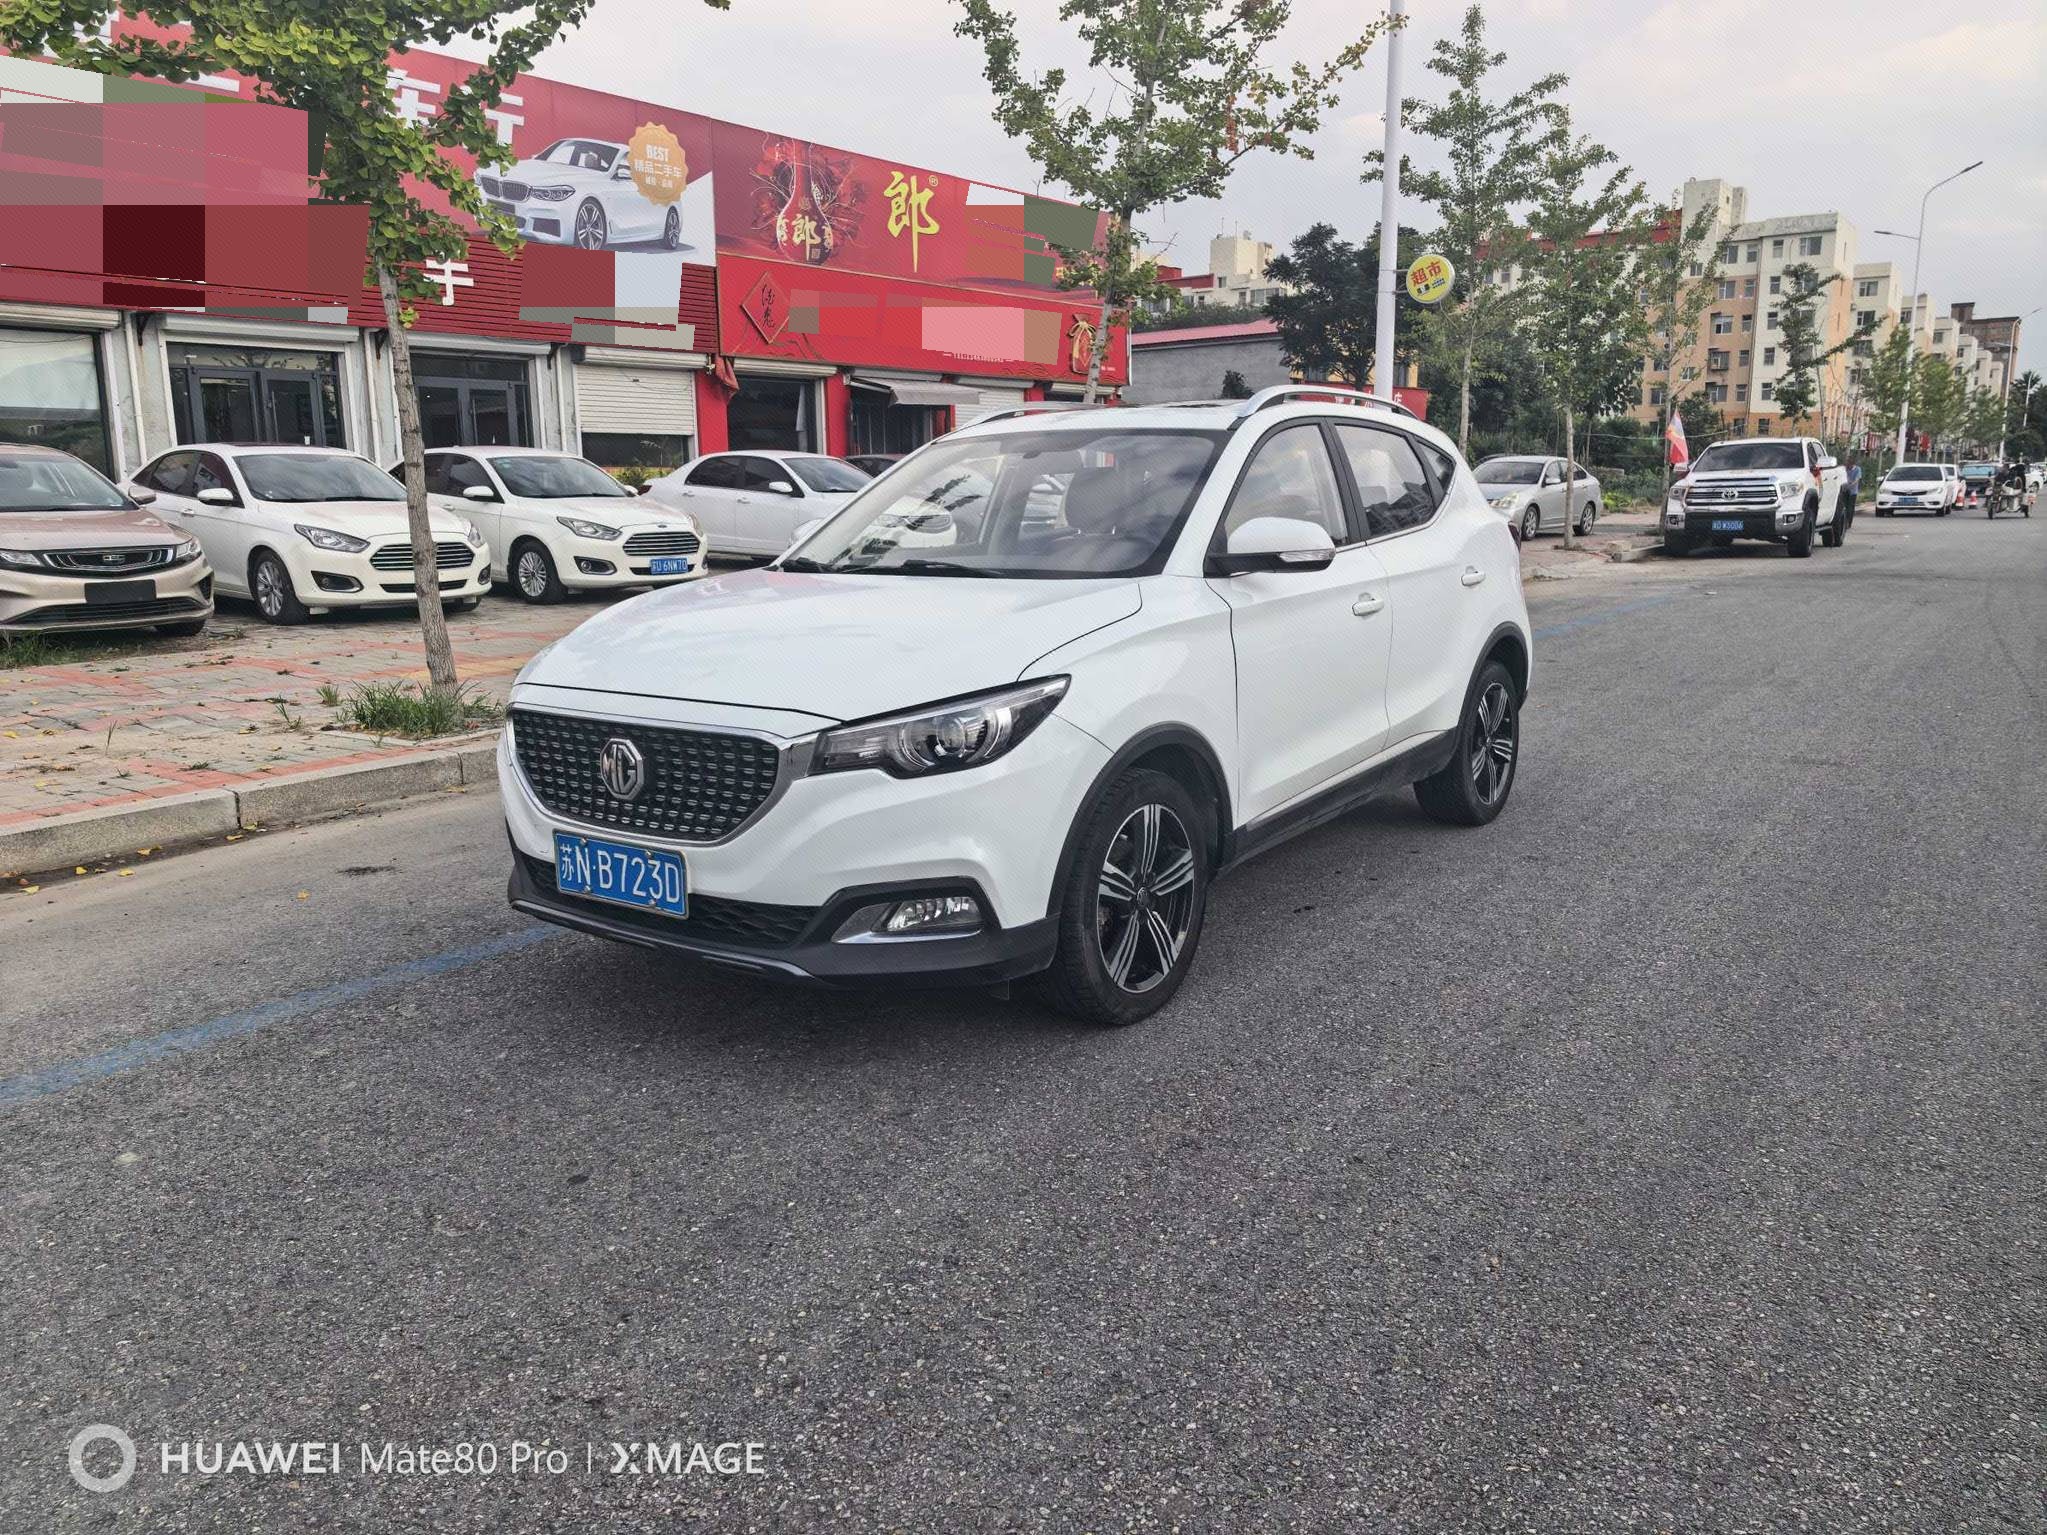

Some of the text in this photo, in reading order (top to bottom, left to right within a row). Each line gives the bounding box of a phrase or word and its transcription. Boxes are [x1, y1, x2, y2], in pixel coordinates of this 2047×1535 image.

[635, 160, 682, 177] 精品二手车
[646, 144, 669, 162] BEST
[792, 213, 821, 260] 郎
[884, 171, 940, 273] 郎
[1411, 261, 1442, 287] 超市
[602, 744, 637, 793] MG
